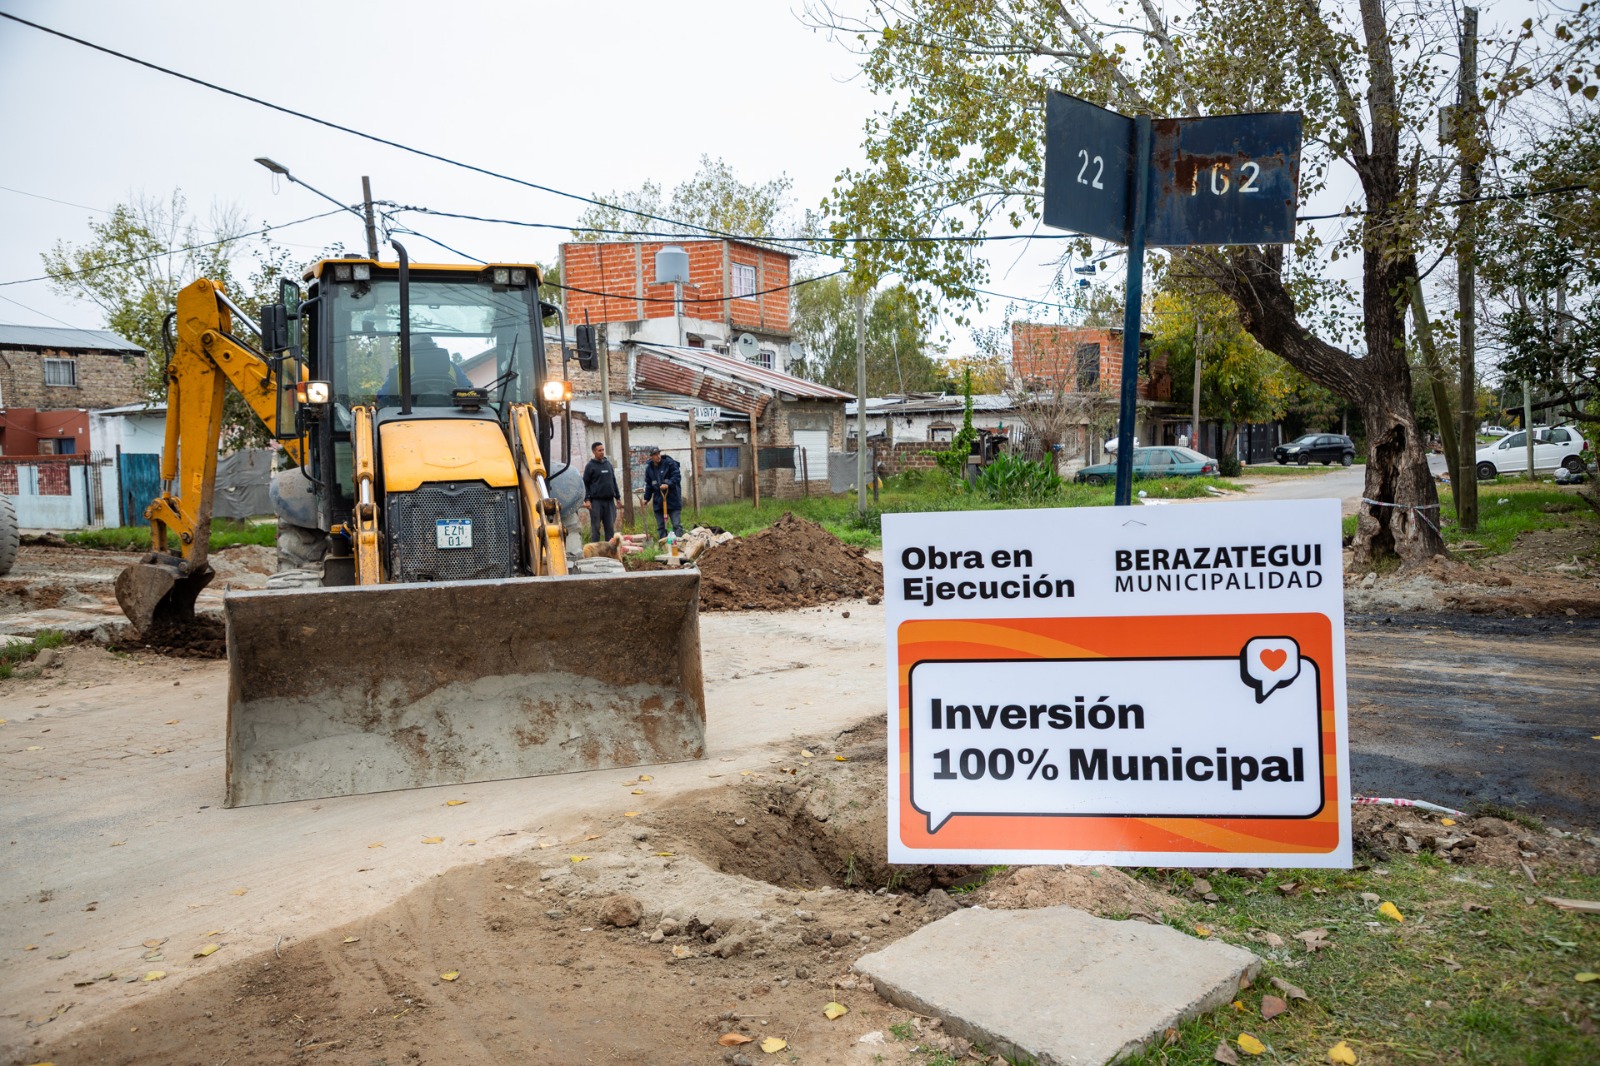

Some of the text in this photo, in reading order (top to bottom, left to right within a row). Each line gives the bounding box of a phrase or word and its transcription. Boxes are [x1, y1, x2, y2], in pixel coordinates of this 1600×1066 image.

[1077, 149, 1104, 190] 22
[1191, 161, 1260, 197] 162
[700, 407, 718, 417] VENTA
[448, 536, 461, 546] 01
[901, 545, 1033, 570] Obra en
[1114, 543, 1322, 572] BERAZATEGUI
[902, 574, 1076, 607] Ejecución
[1114, 570, 1323, 593] MUNICIPALIDAD
[931, 695, 1145, 730] Inversión
[933, 747, 1304, 791] 100% Municipal
